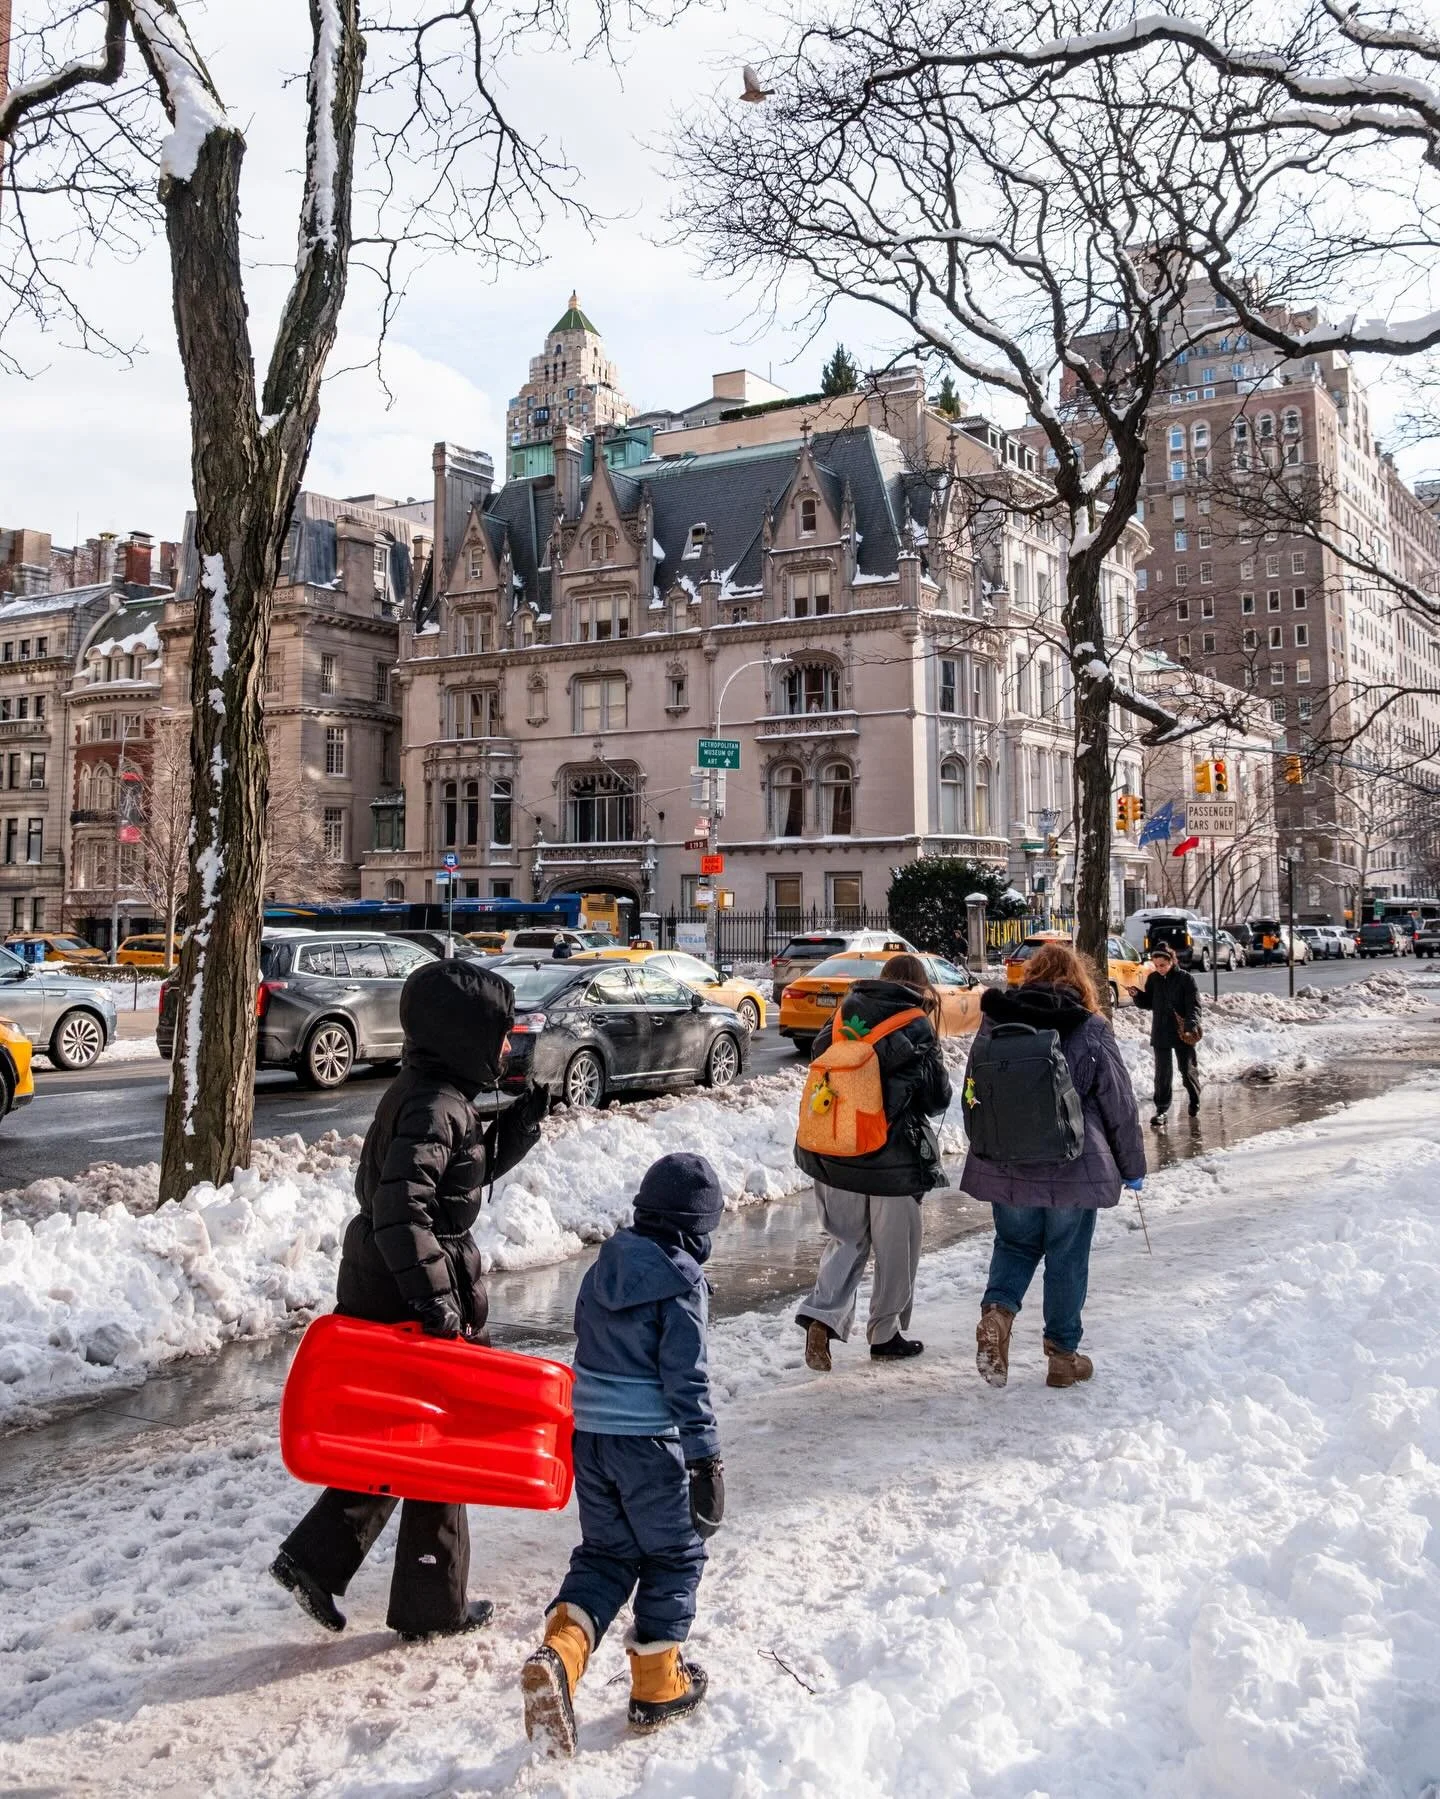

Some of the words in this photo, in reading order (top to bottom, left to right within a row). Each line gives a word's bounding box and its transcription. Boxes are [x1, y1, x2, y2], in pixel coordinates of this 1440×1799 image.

[700, 741, 739, 749] METROPOLITAN
[1189, 806, 1234, 817] PASSENGER
[1189, 820, 1209, 830] CARS
[1214, 820, 1234, 831] ONLY
